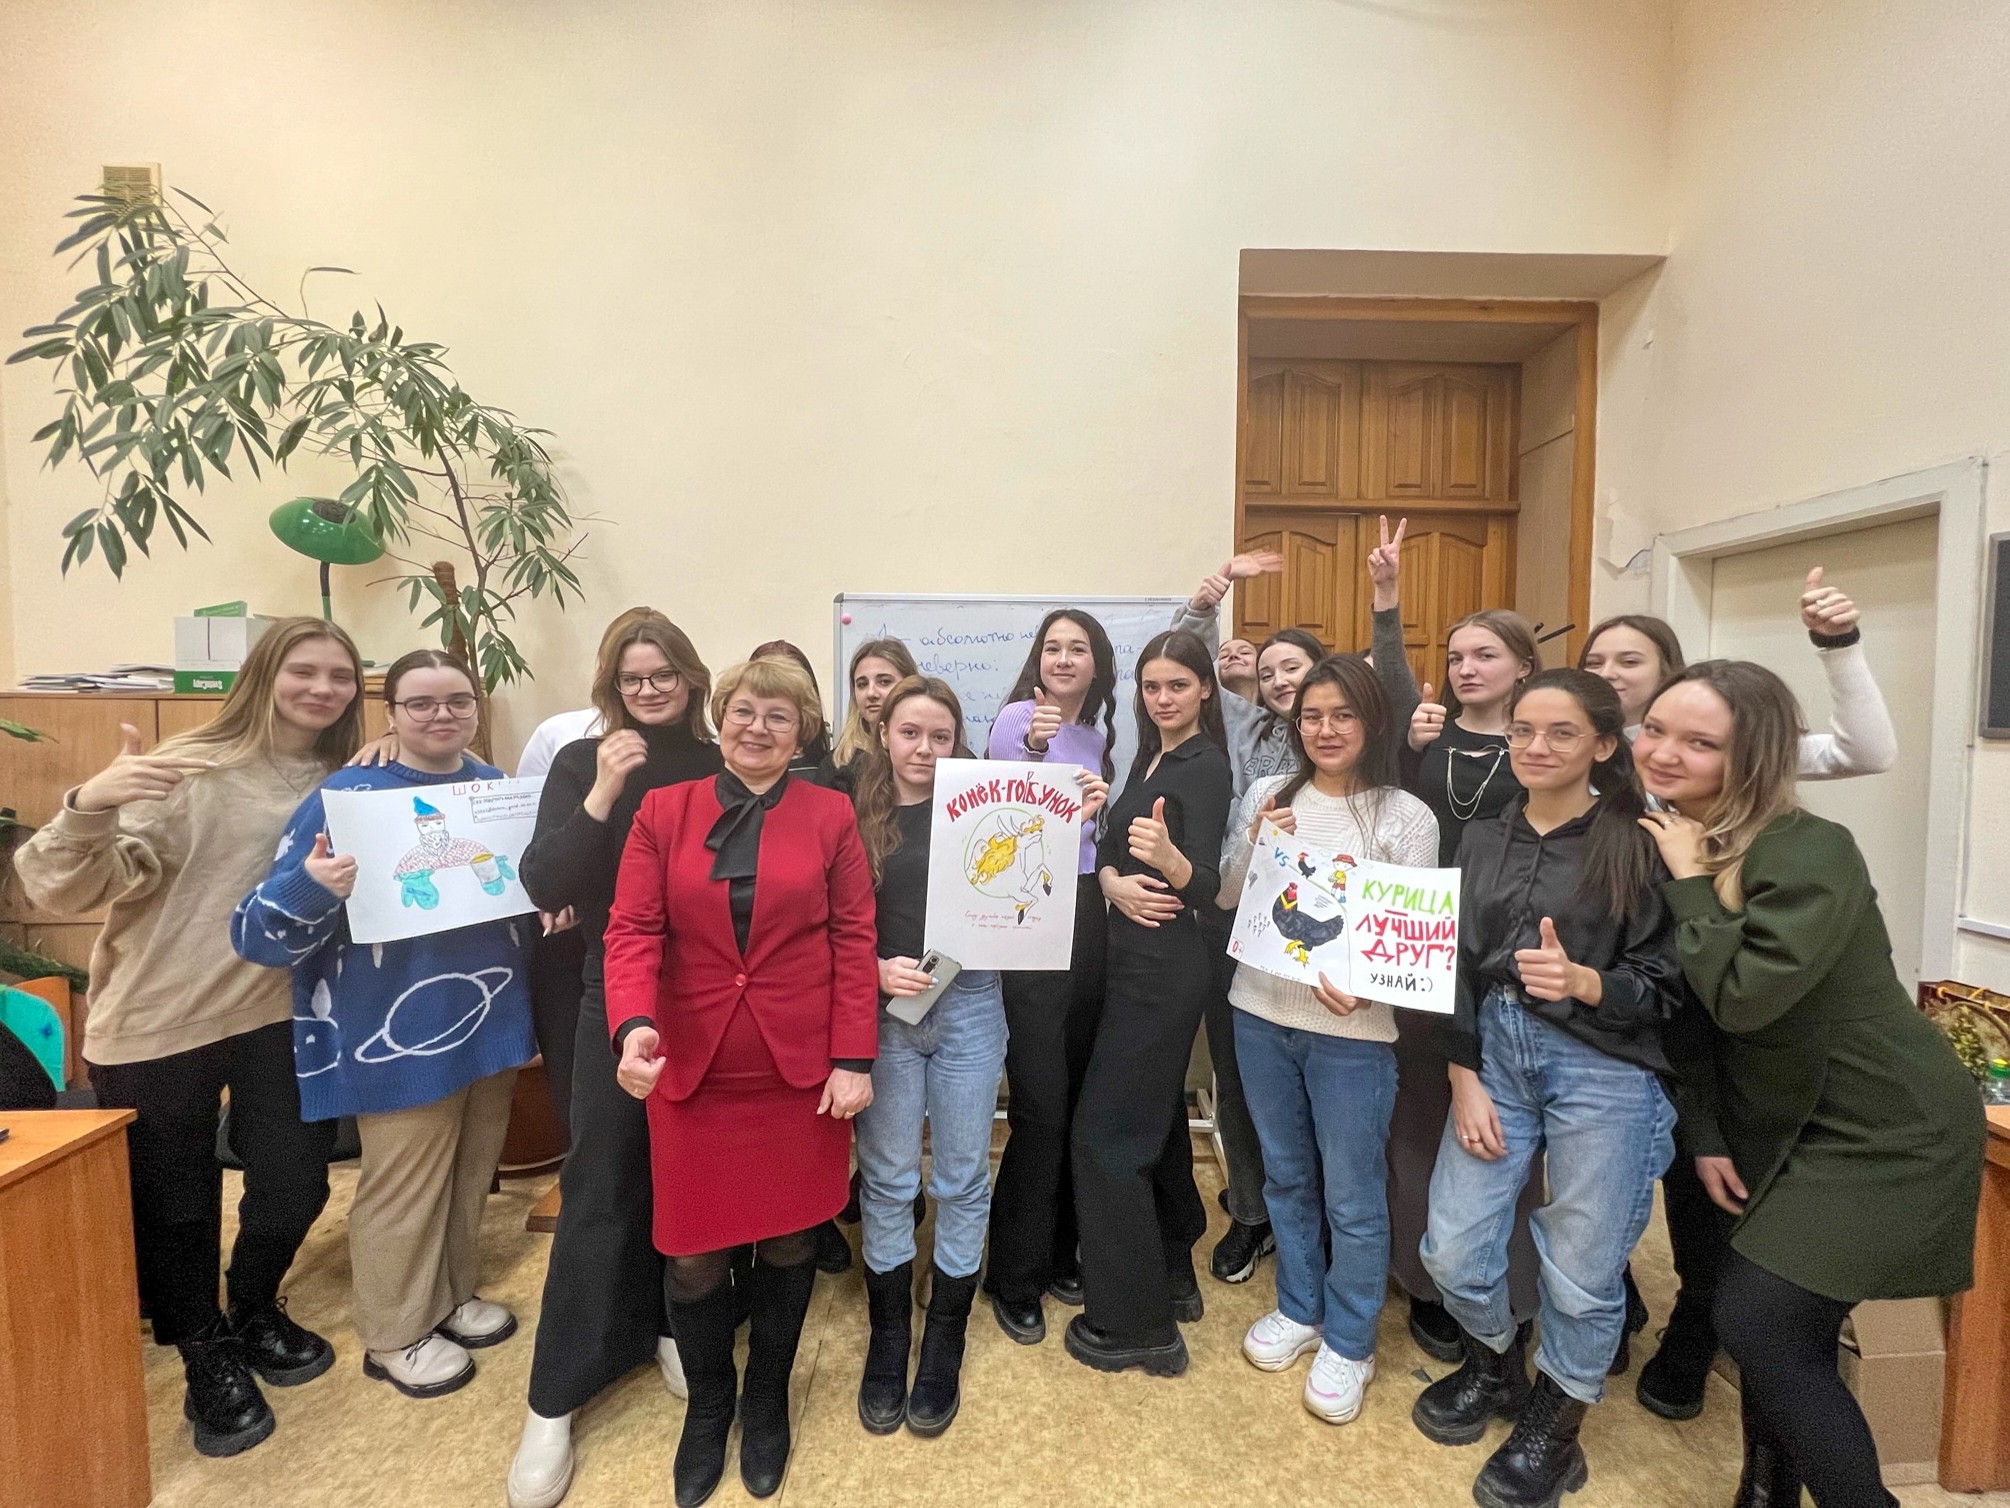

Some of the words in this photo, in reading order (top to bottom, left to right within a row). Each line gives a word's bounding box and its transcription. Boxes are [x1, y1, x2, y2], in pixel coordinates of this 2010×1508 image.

[920, 627, 1015, 646] абсолютно
[1361, 879, 1454, 915] КУРИЦА
[1355, 912, 1456, 941] ЛУЧШИЙ
[1359, 938, 1456, 971] ДРУГ?
